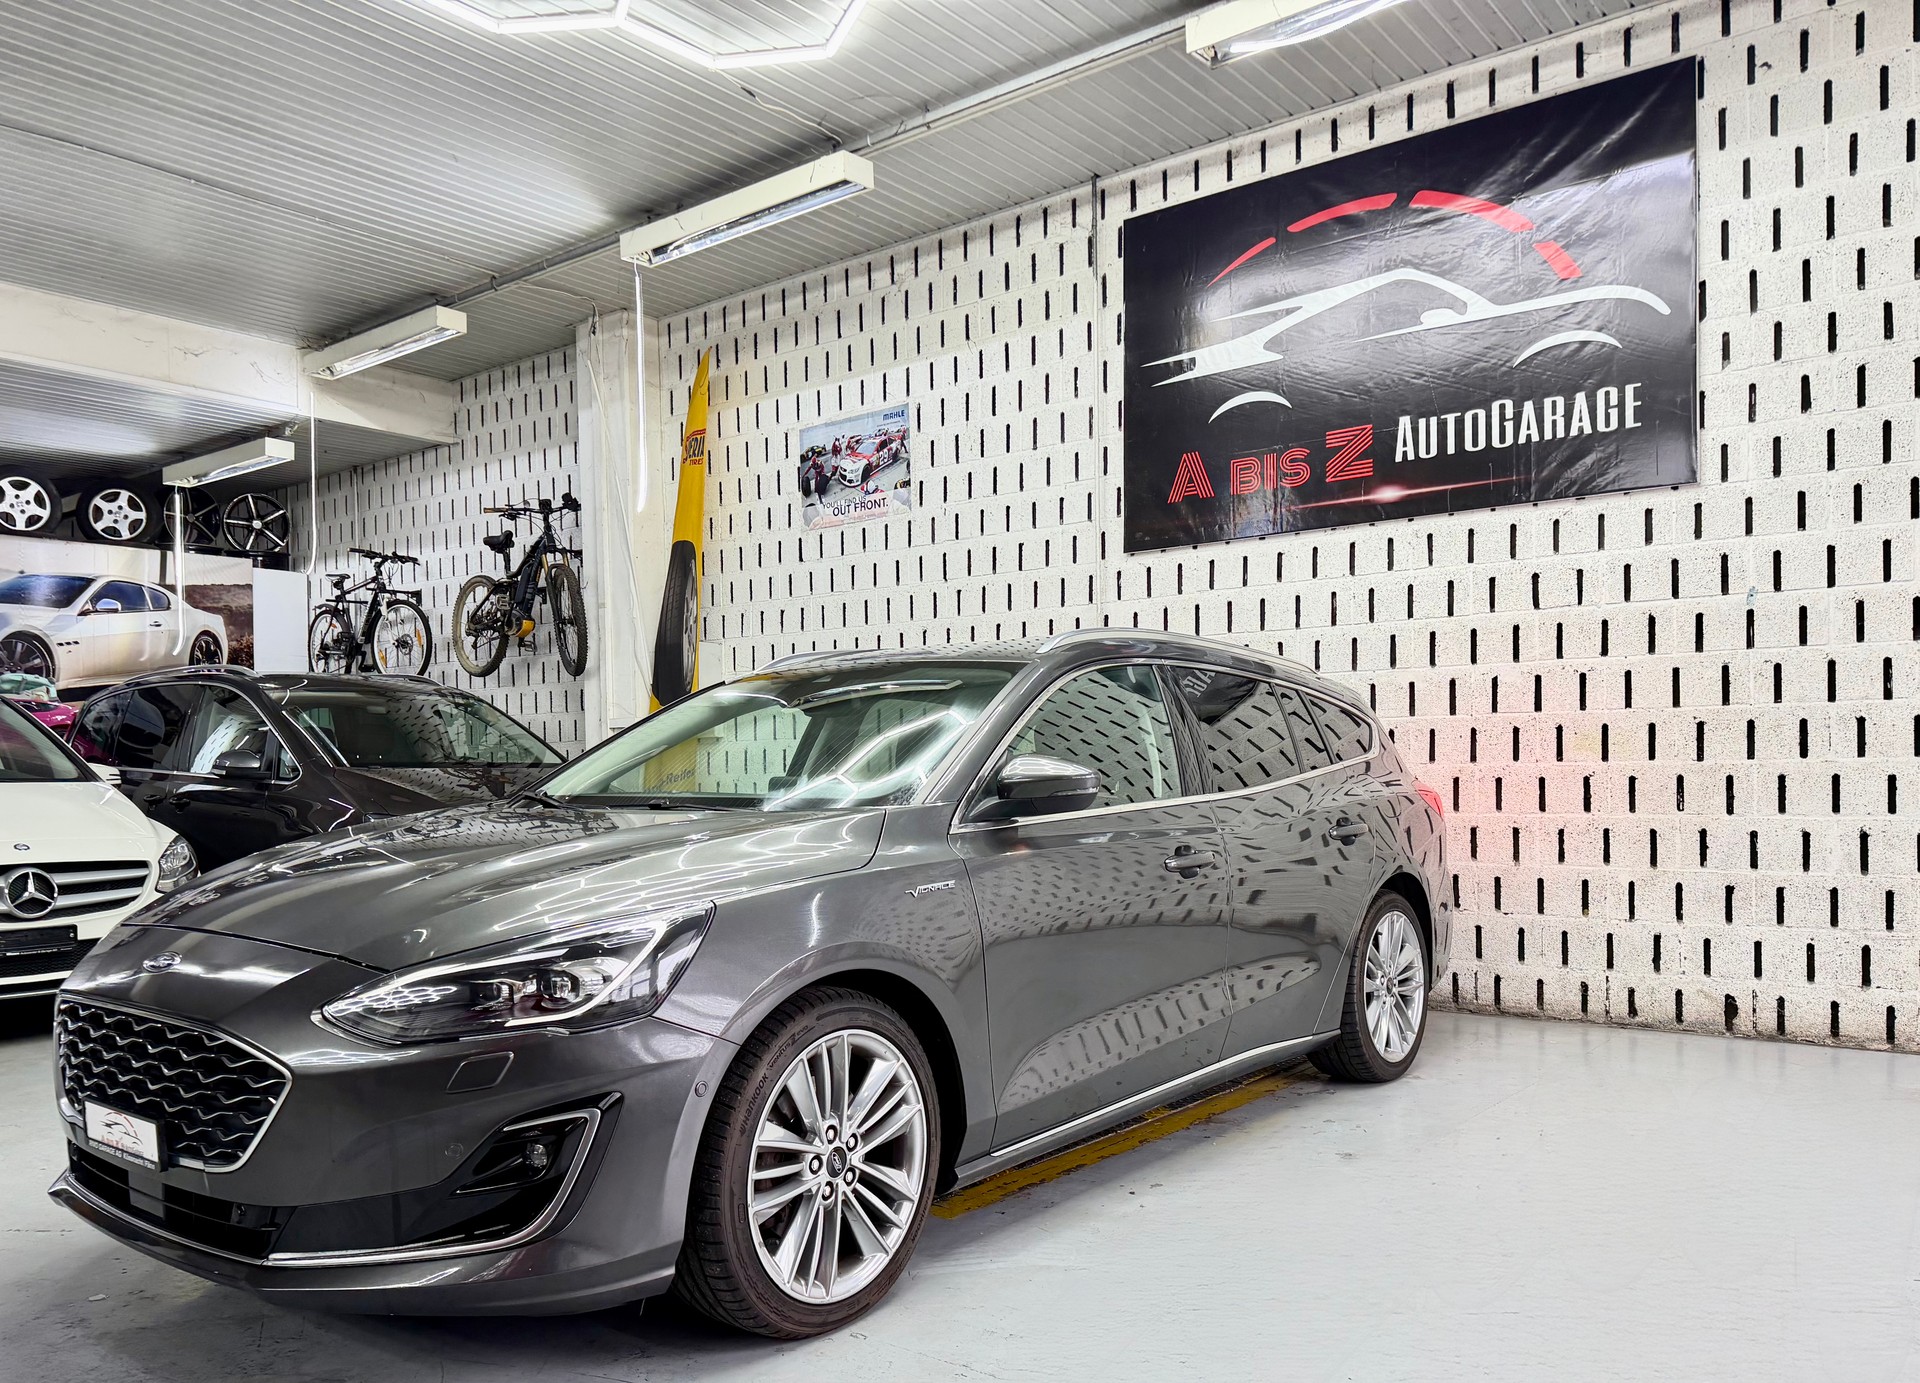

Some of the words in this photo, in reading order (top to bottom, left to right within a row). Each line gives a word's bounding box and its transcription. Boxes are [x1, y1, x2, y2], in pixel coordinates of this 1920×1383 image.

[882, 409, 905, 421] MAHLE
[1168, 451, 1215, 504] A
[1230, 447, 1311, 496] BIS
[1325, 424, 1374, 483] Z
[832, 504, 852, 517] OUT
[854, 497, 889, 513] FRONT.
[858, 495, 867, 503] US
